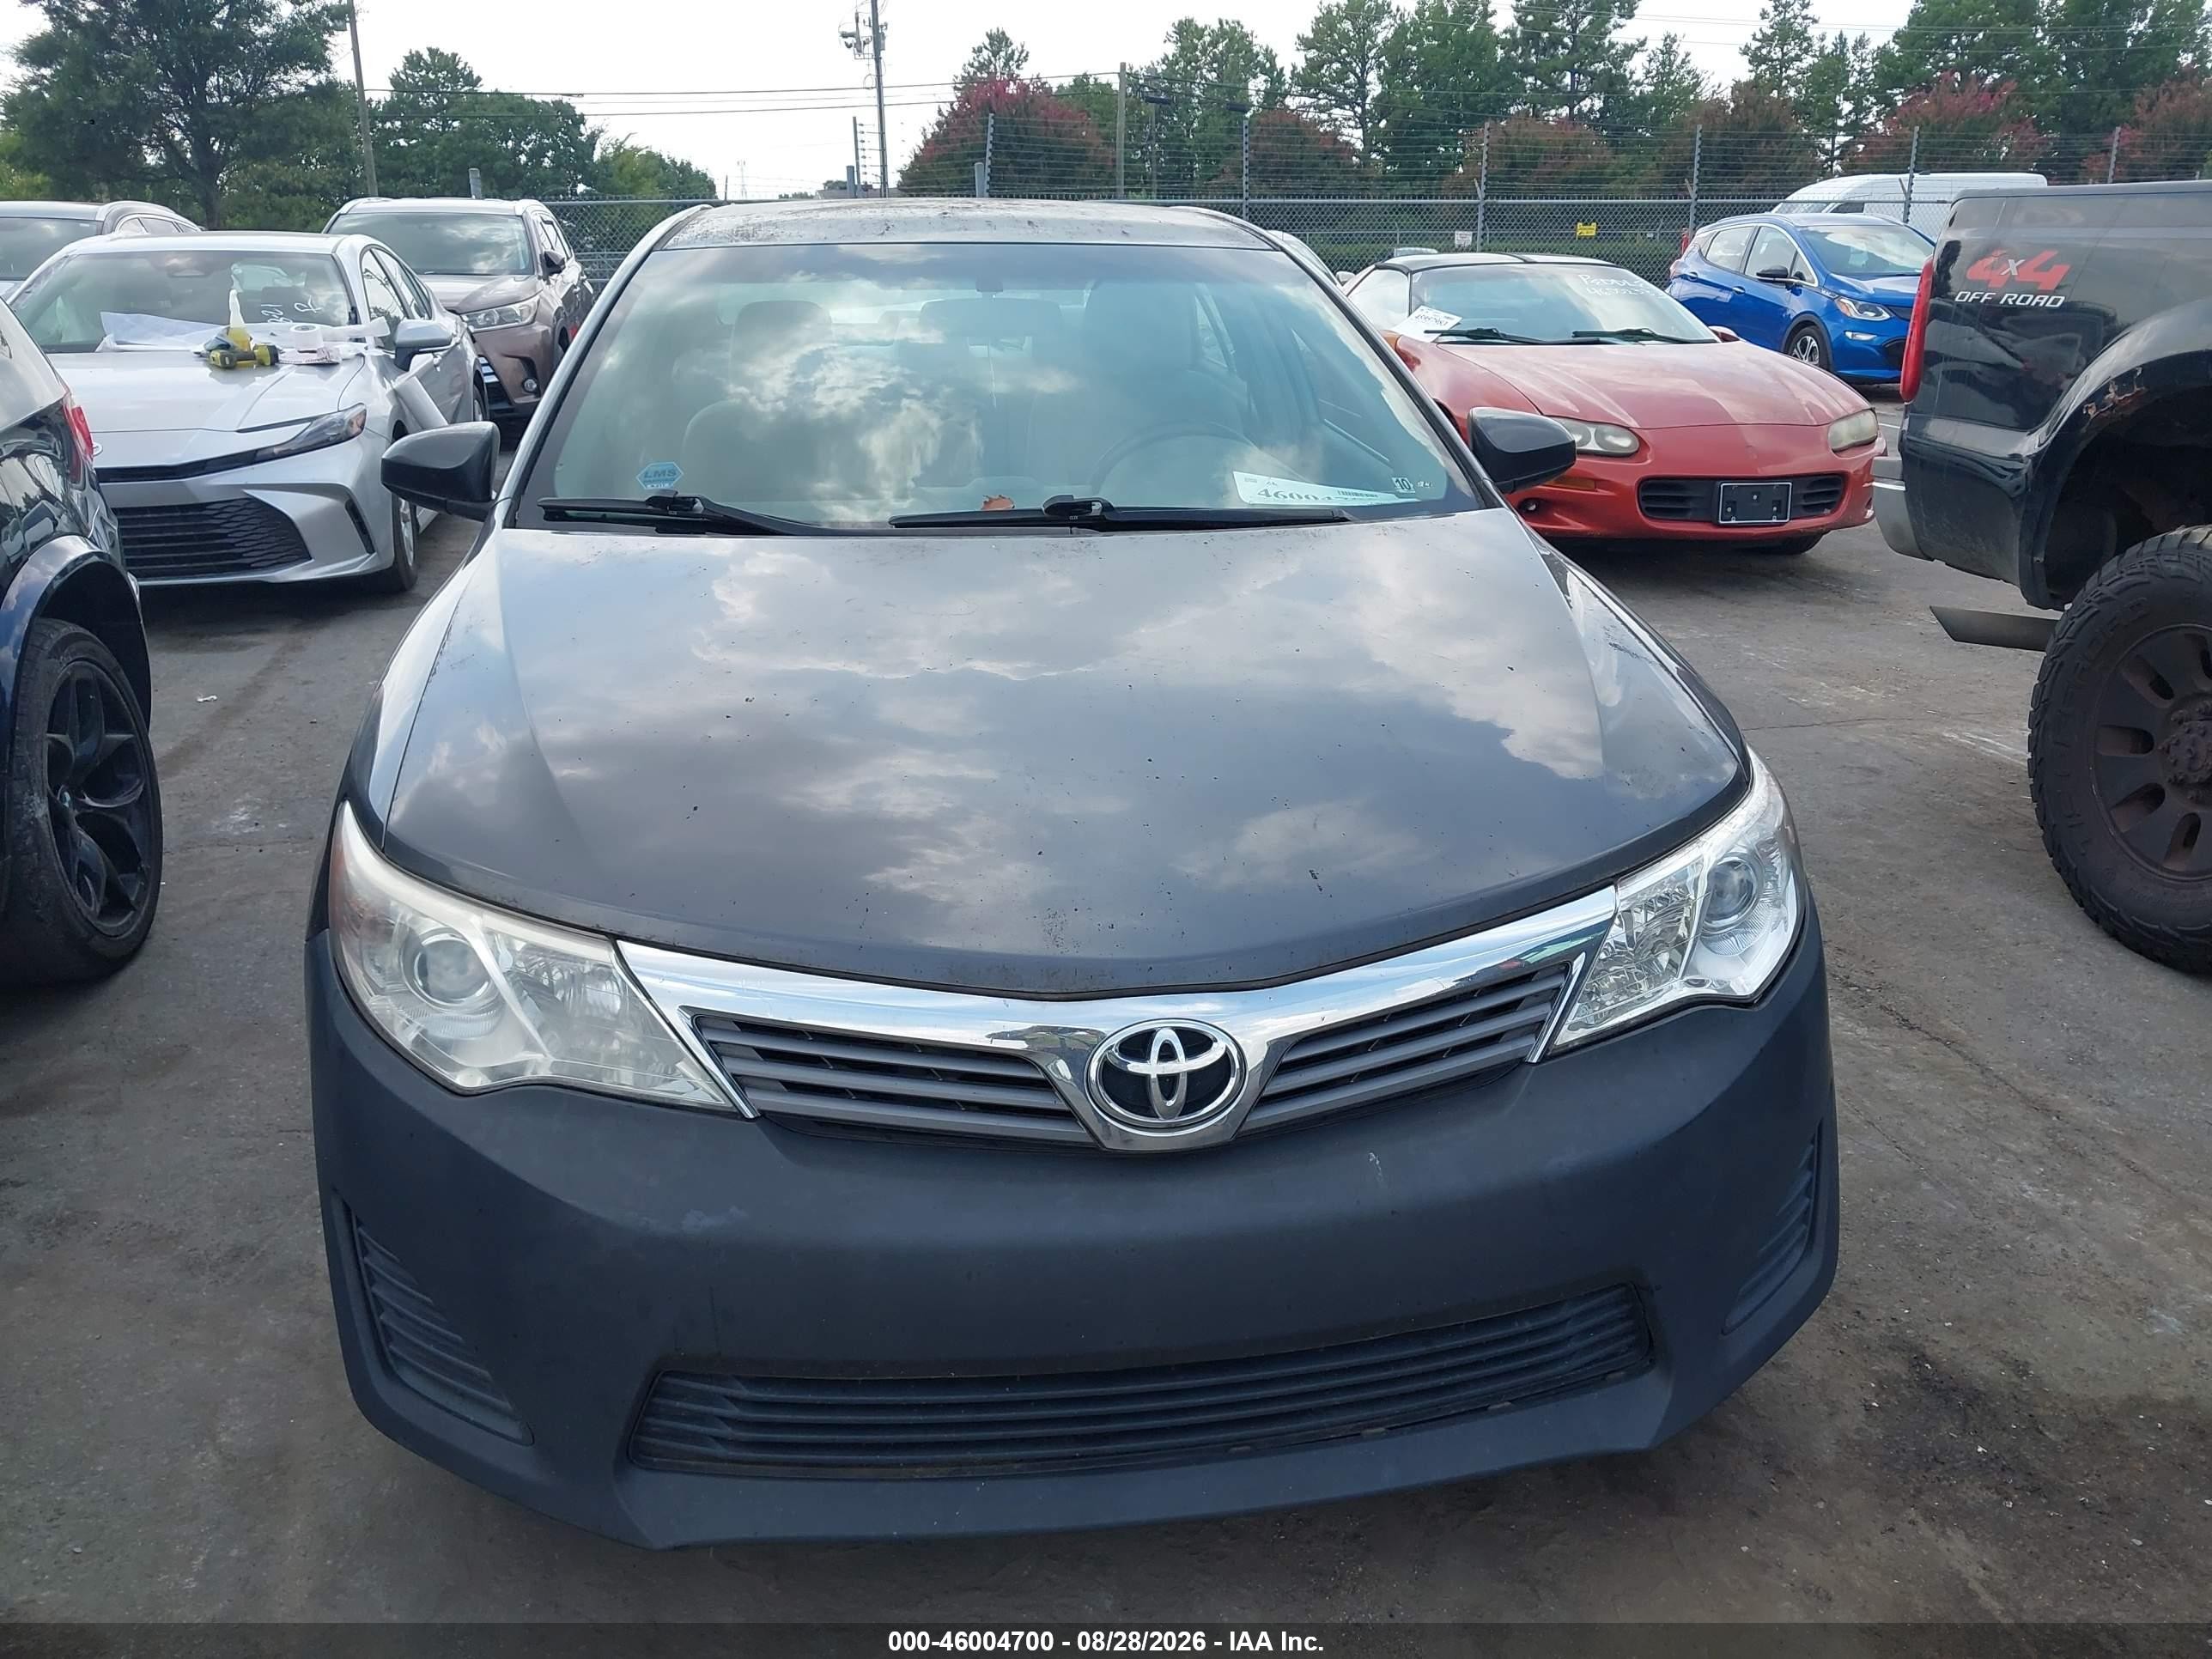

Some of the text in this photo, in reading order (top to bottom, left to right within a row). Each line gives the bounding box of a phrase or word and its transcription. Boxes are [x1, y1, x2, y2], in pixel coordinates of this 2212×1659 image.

[1954, 291, 2066, 307] OFF ROAD
[1395, 478, 1412, 490] 10
